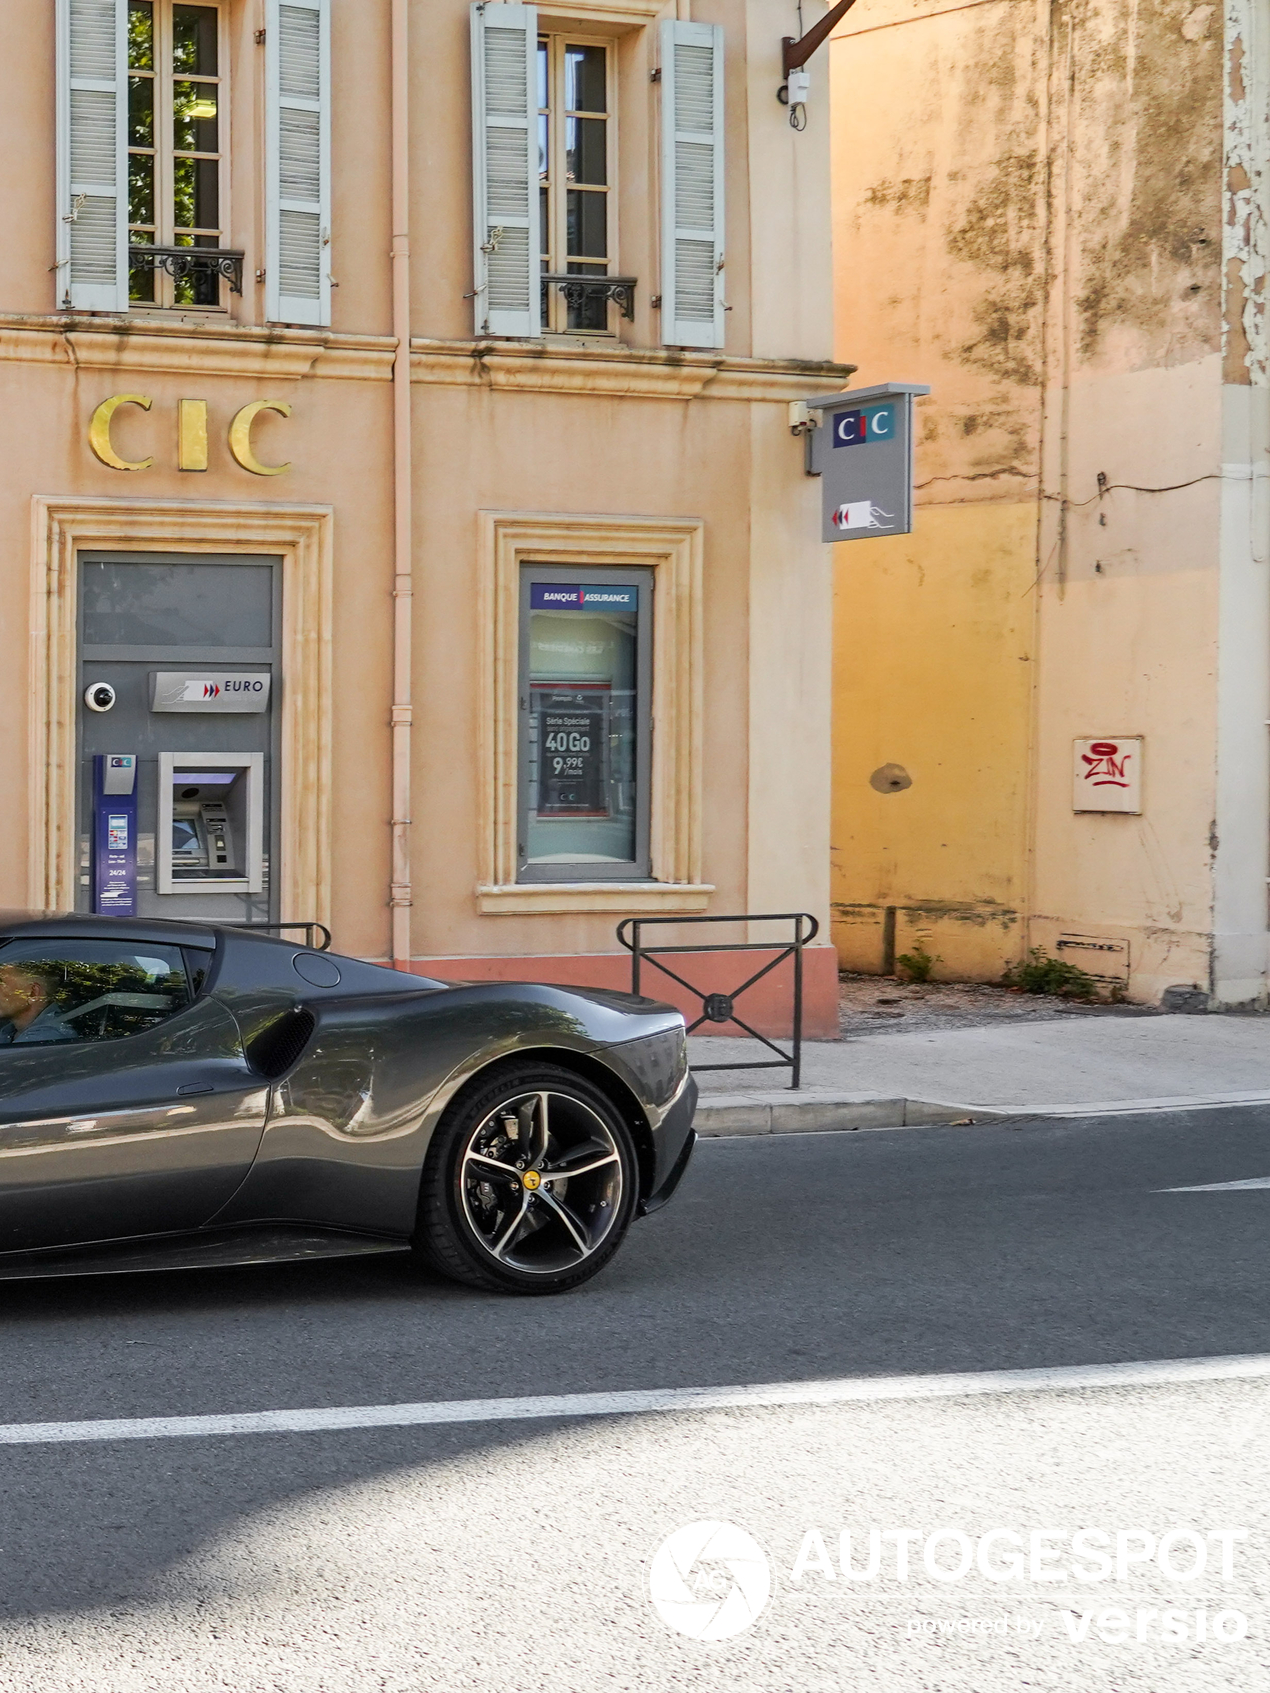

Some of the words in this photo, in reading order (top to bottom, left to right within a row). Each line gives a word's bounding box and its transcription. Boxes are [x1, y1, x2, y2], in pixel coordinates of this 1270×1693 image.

[838, 411, 889, 440] CIC
[88, 393, 292, 476] CIC
[543, 592, 578, 602] BANQUE
[584, 593, 630, 603] ASSURANCE
[224, 680, 264, 692] EURO
[112, 758, 130, 766] CIC
